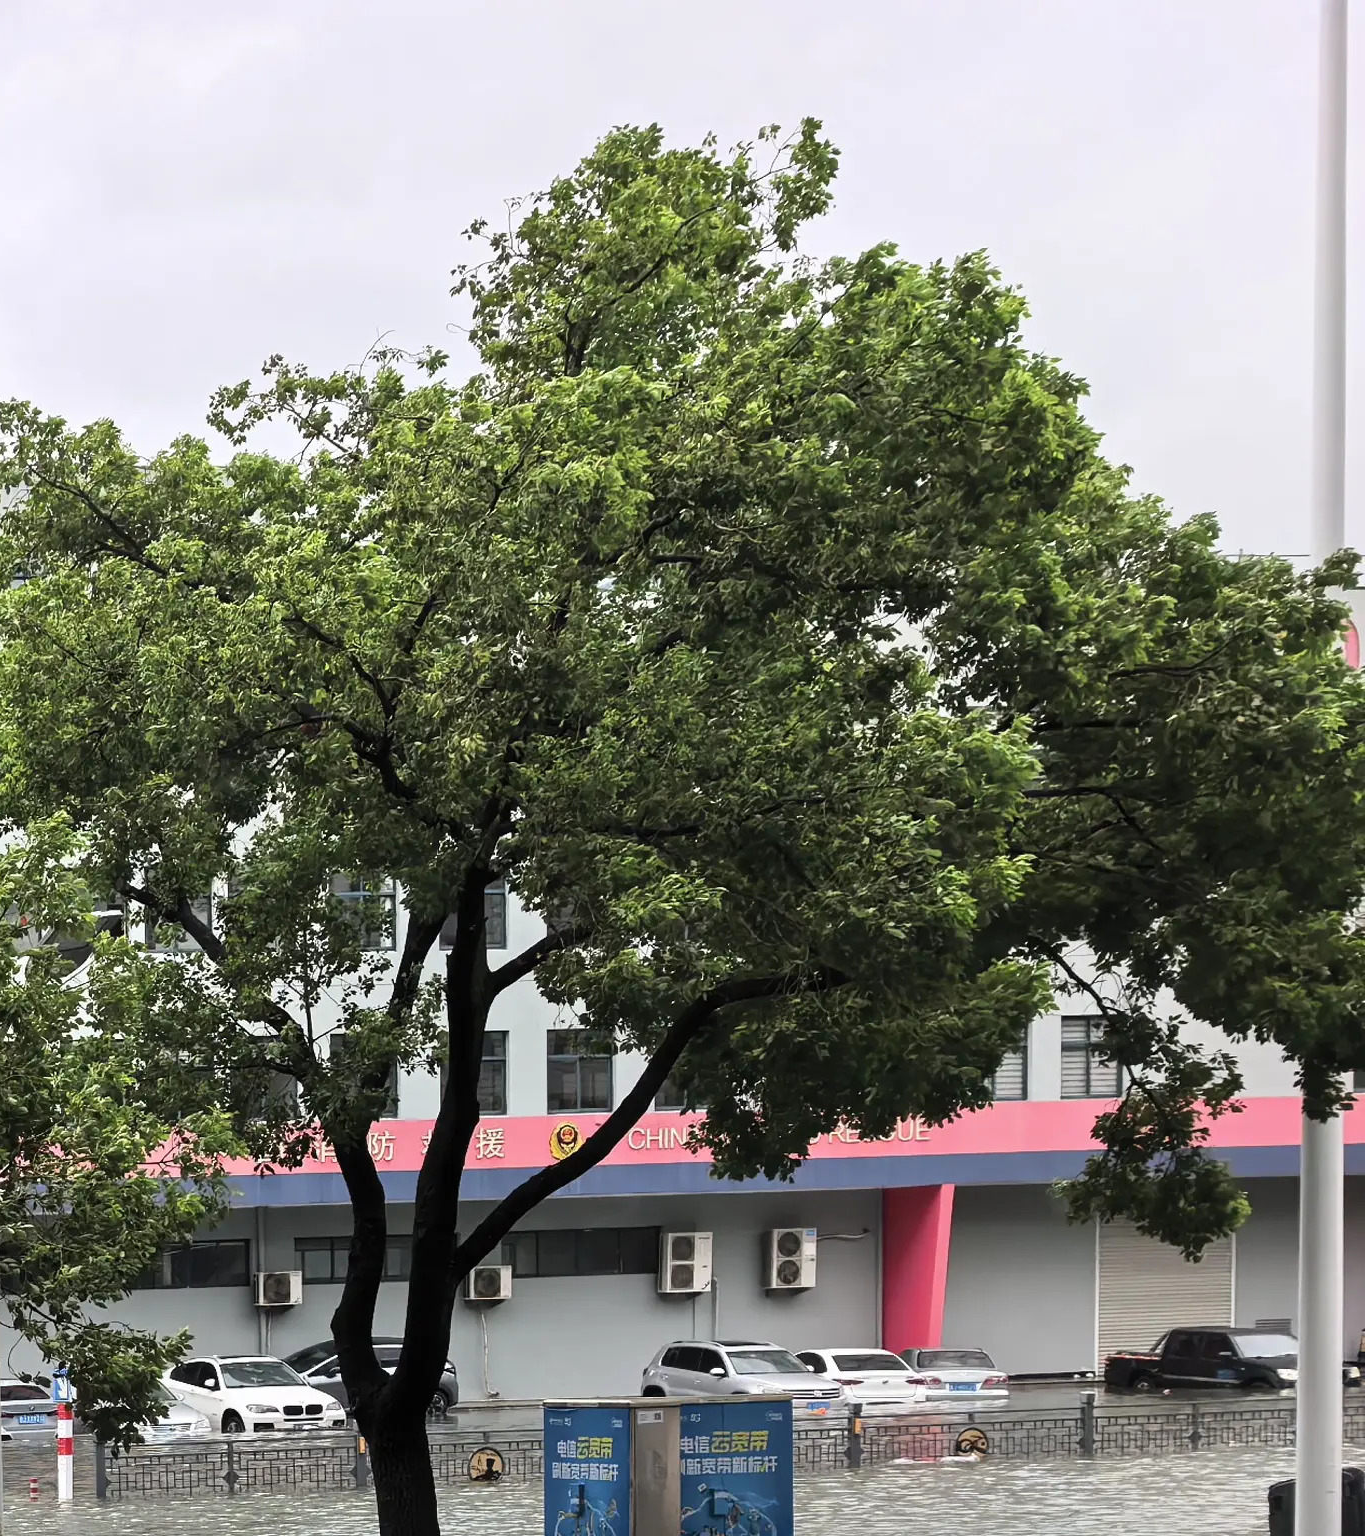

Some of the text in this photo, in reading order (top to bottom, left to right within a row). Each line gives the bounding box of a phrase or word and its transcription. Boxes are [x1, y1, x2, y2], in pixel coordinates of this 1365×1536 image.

[627, 1126, 703, 1151] CHIN
[557, 1436, 614, 1459] 电信云宽带
[680, 1430, 769, 1454] 电信云宽带
